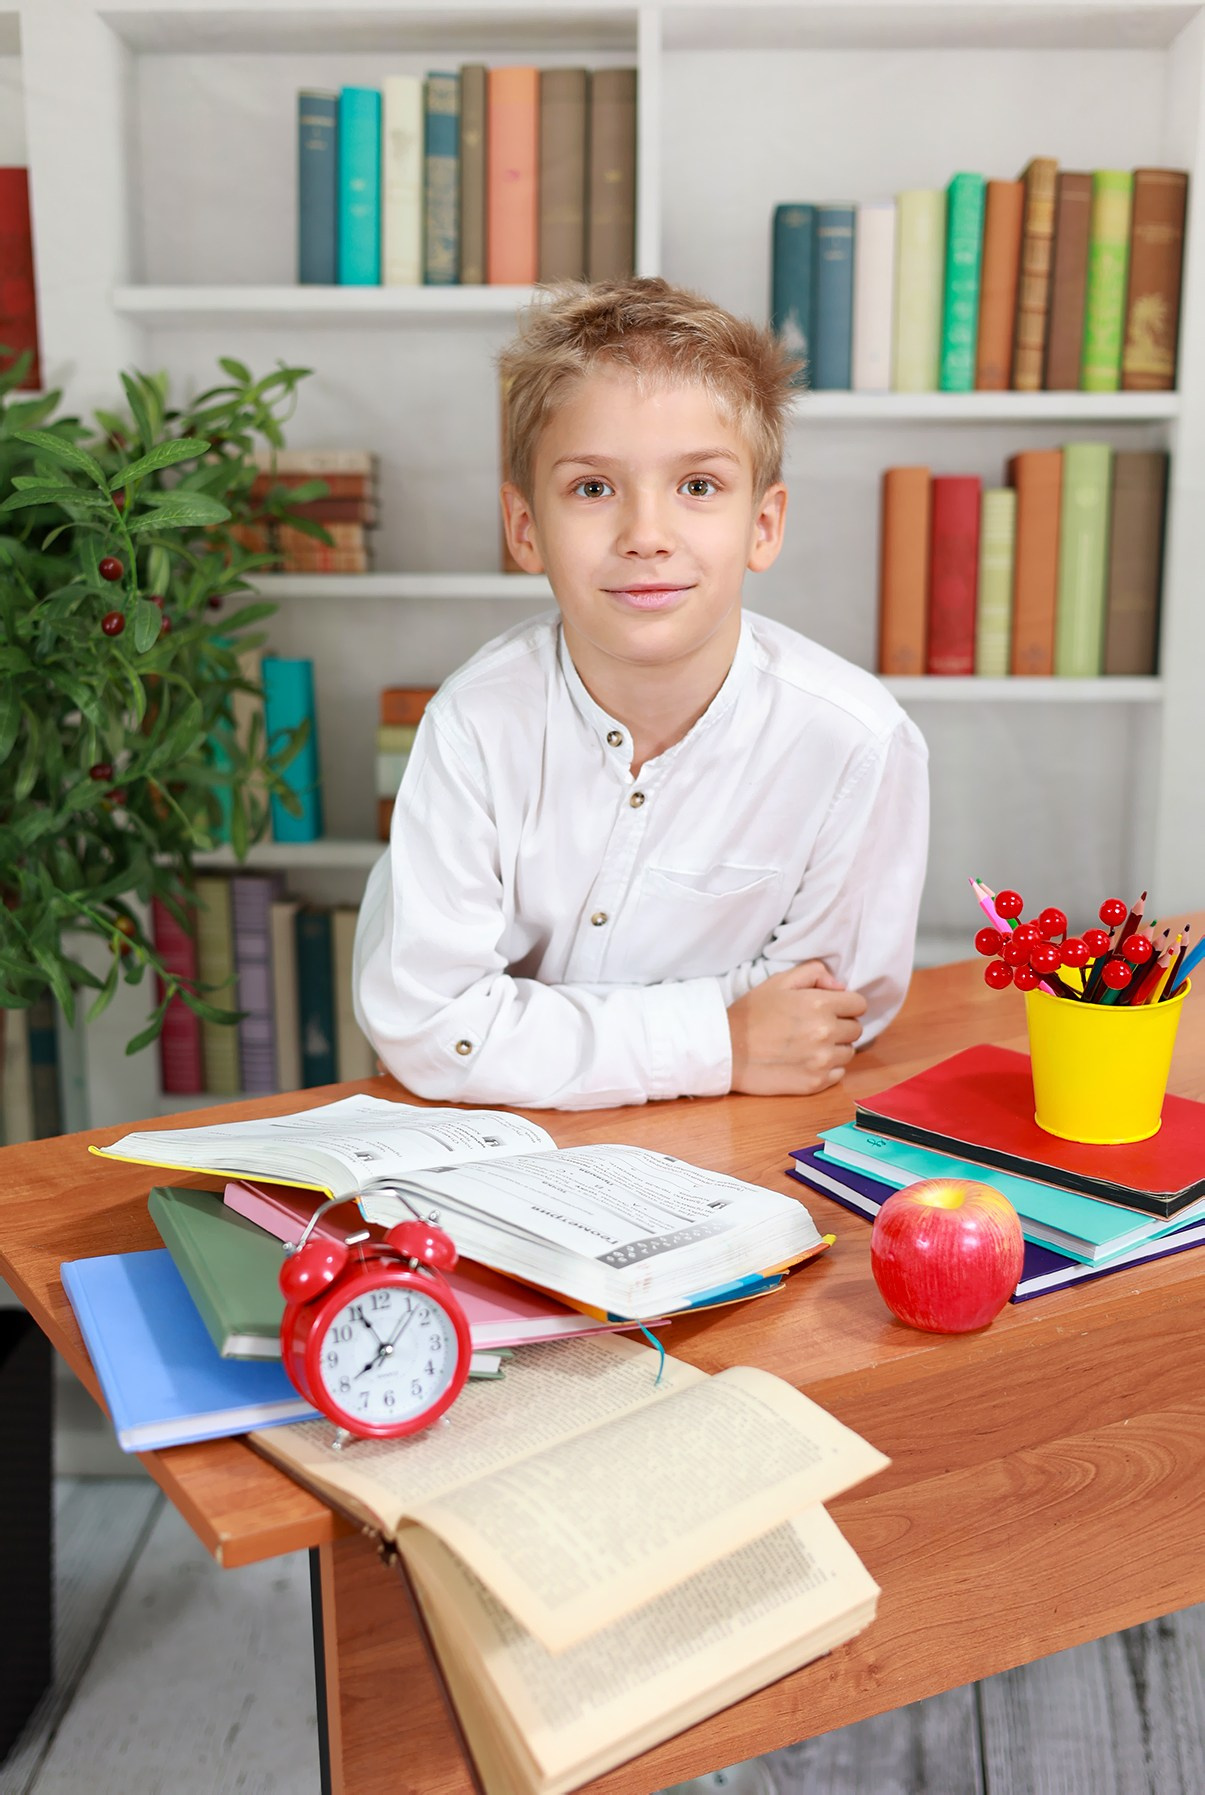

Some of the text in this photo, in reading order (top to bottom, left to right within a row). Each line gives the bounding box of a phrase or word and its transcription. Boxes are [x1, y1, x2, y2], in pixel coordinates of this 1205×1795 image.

[530, 1206, 619, 1245] Геометрия
[370, 1291, 391, 1311] 12
[404, 1295, 412, 1313] 1
[348, 1304, 363, 1322] 11
[419, 1308, 431, 1326] 2
[332, 1324, 353, 1344] 10
[430, 1333, 442, 1351] 3
[327, 1350, 338, 1368] 9
[424, 1359, 435, 1375] 4
[340, 1375, 351, 1393] 8
[411, 1378, 422, 1396] 5
[359, 1390, 370, 1408] 7
[384, 1389, 395, 1407] 6
